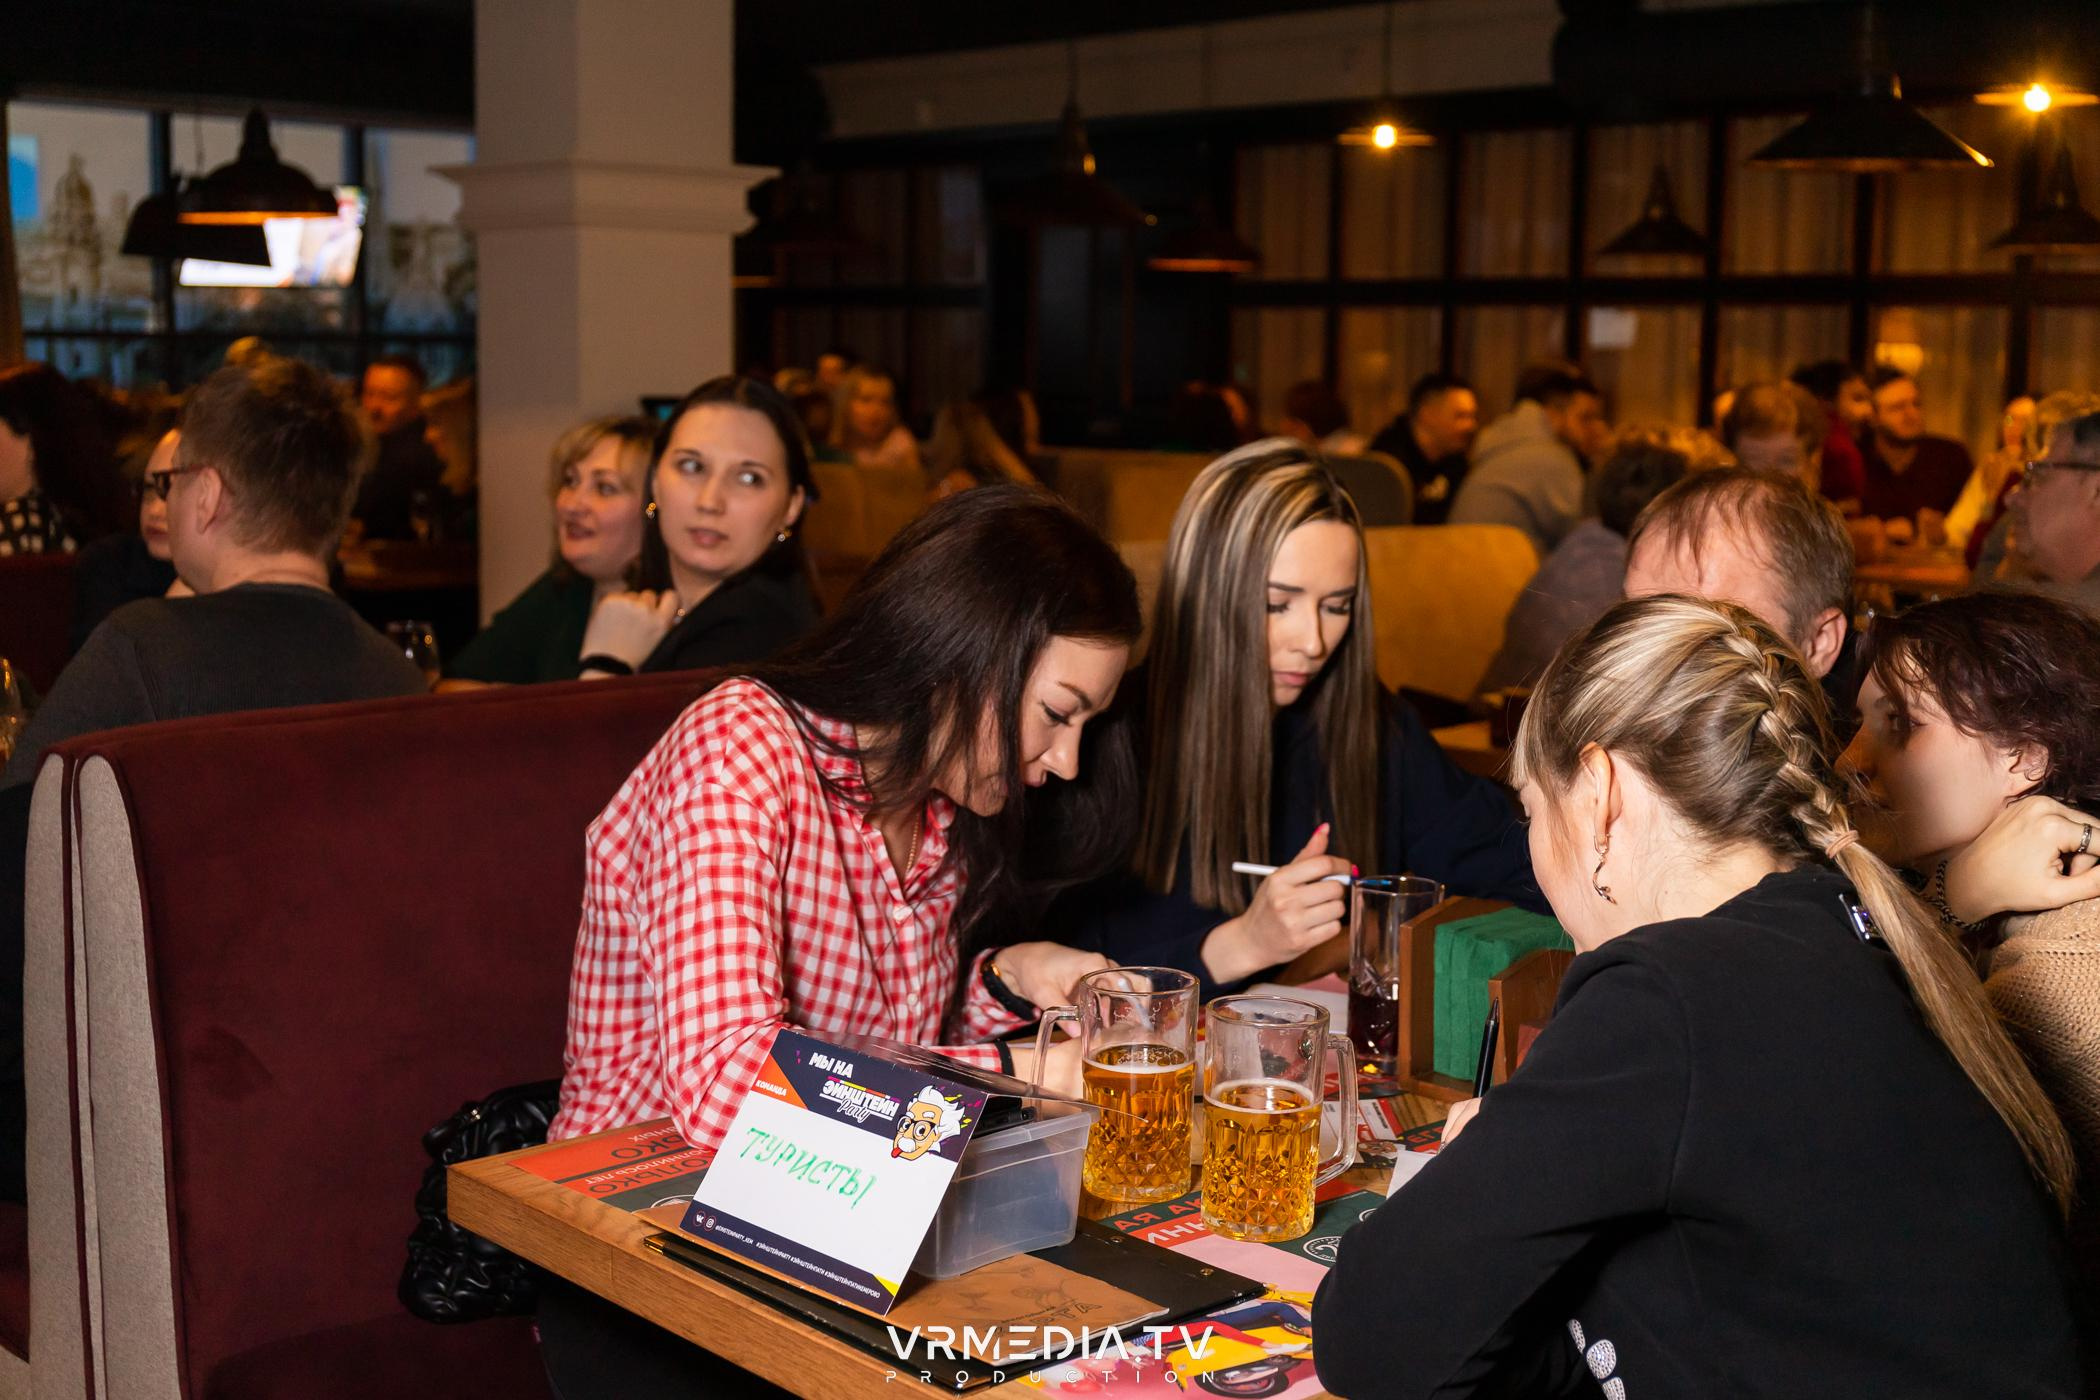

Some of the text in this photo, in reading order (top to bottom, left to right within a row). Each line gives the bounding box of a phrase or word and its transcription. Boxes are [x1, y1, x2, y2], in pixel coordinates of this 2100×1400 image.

[808, 1052, 854, 1078] МЫ НА
[837, 1098, 872, 1123] Party
[585, 1173, 614, 1185] ЛЕТ
[739, 1127, 877, 1209] ТУРИСТЫ
